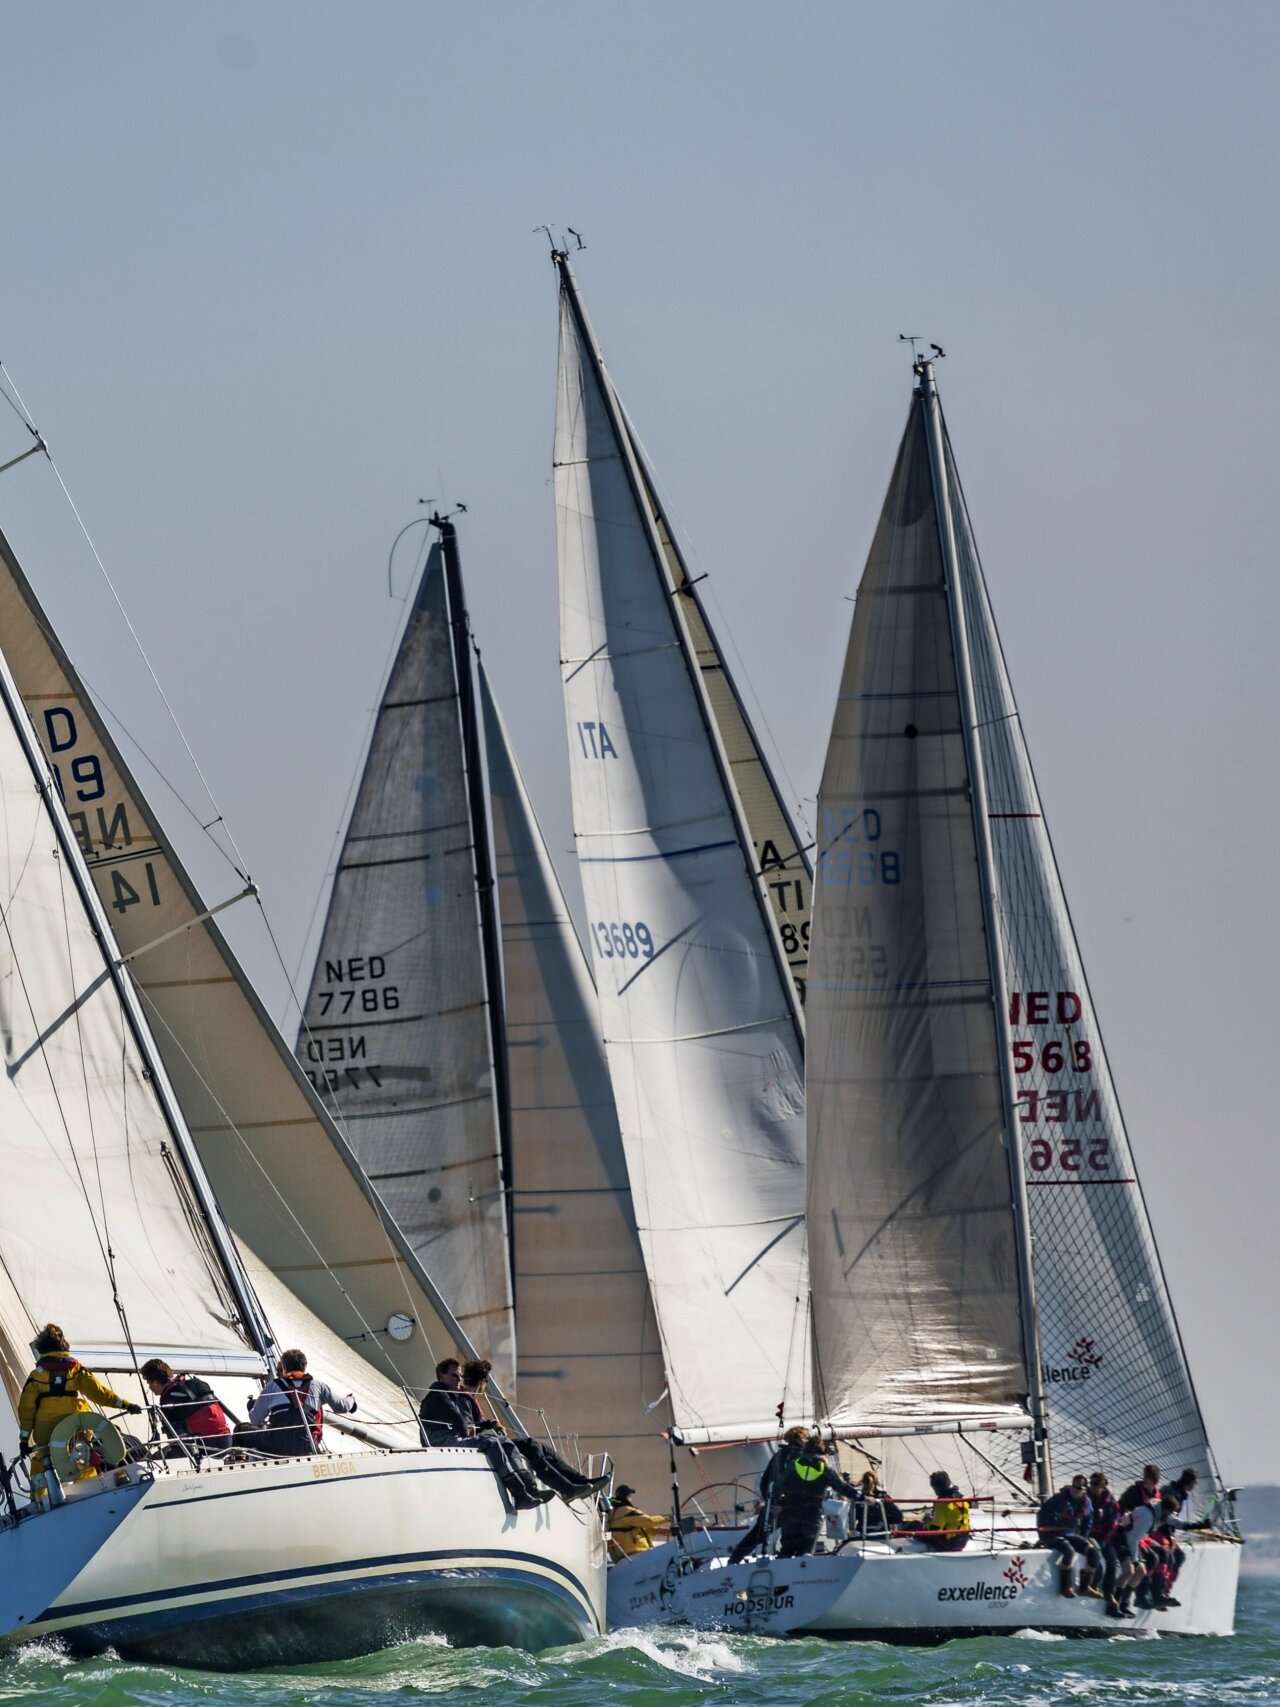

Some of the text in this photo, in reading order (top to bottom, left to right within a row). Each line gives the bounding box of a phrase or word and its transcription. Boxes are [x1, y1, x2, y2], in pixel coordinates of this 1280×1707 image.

[577, 721, 619, 760] ITA
[52, 754, 106, 803] 9
[823, 807, 882, 843] NED
[591, 921, 655, 960] 13689
[326, 956, 386, 984] NED
[318, 986, 400, 1017] 7786
[312, 1461, 357, 1479] BELUGA
[937, 1581, 1018, 1602] exxellence
